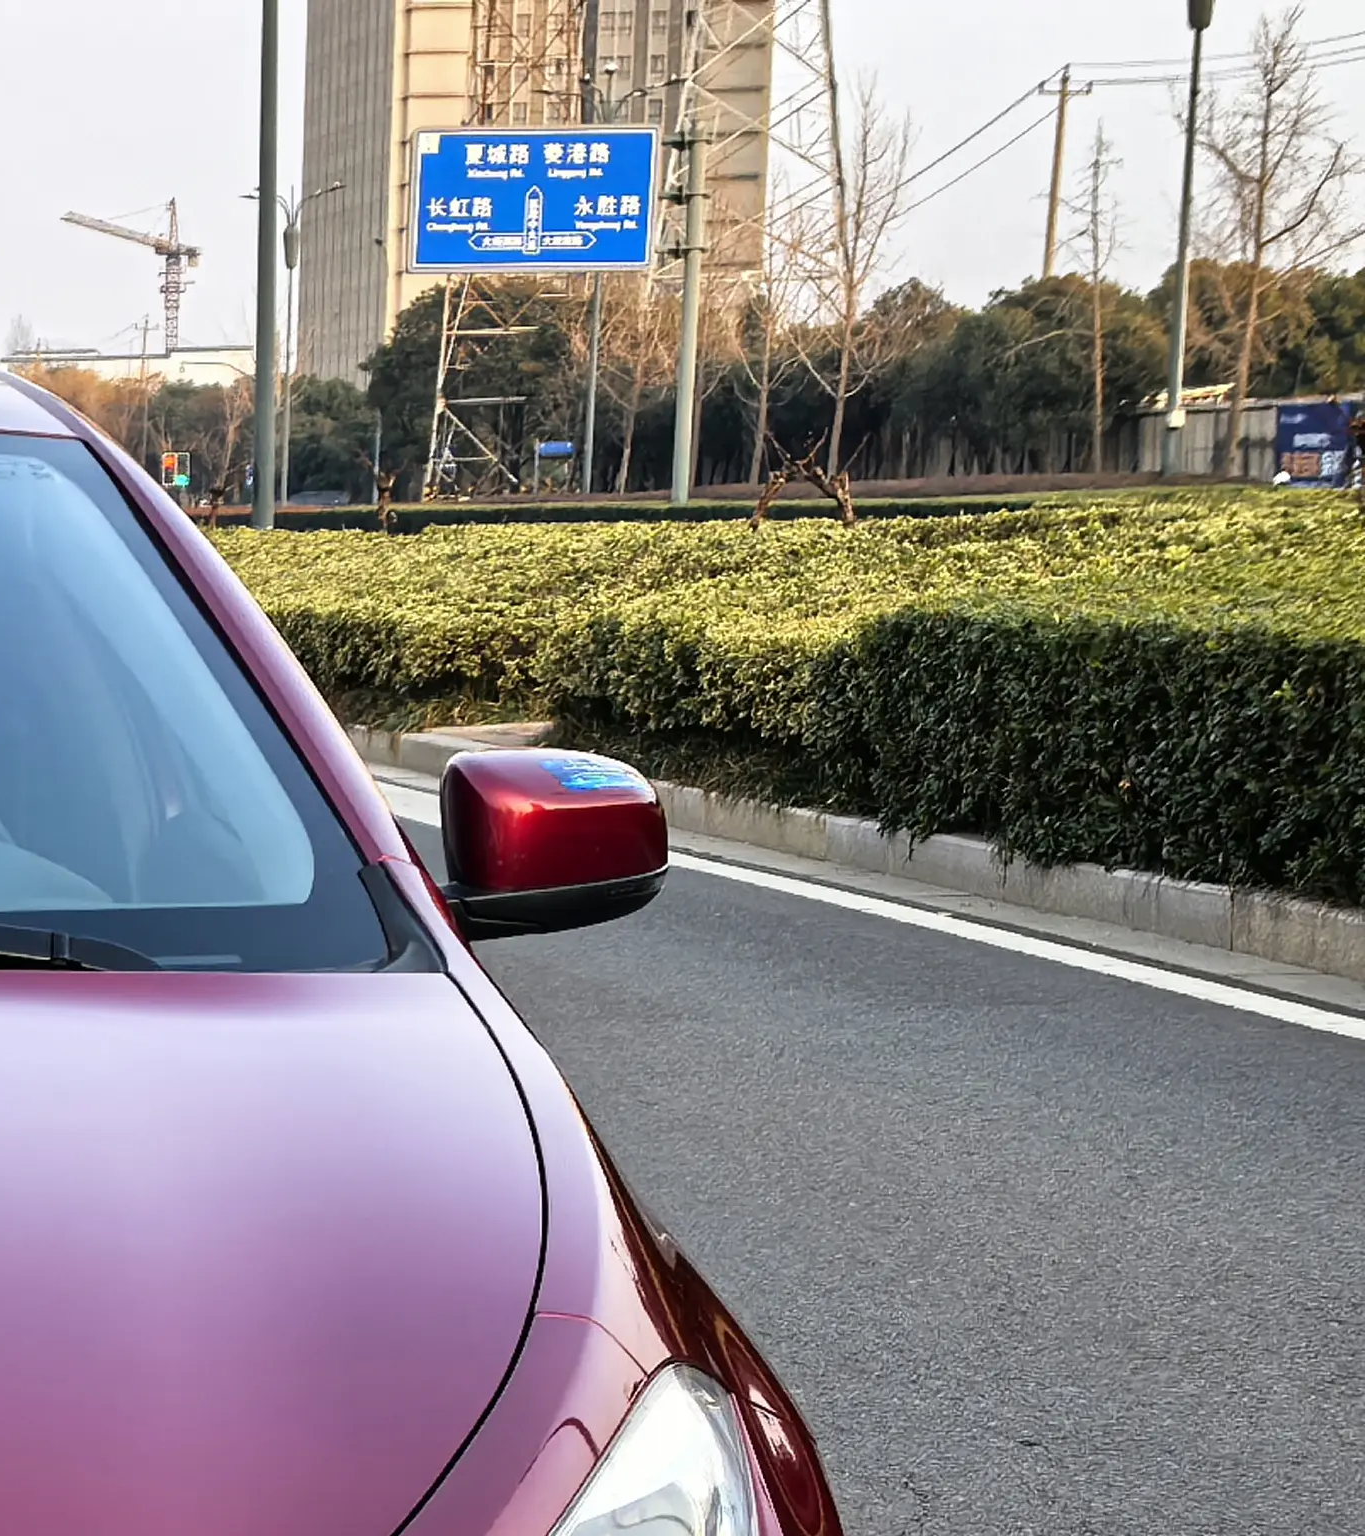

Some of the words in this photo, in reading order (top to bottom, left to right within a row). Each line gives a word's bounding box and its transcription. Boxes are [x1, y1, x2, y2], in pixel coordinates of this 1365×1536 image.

[464, 143, 530, 166] 夏城路
[425, 196, 493, 218] 长虹路
[573, 195, 642, 217] 永胜路
